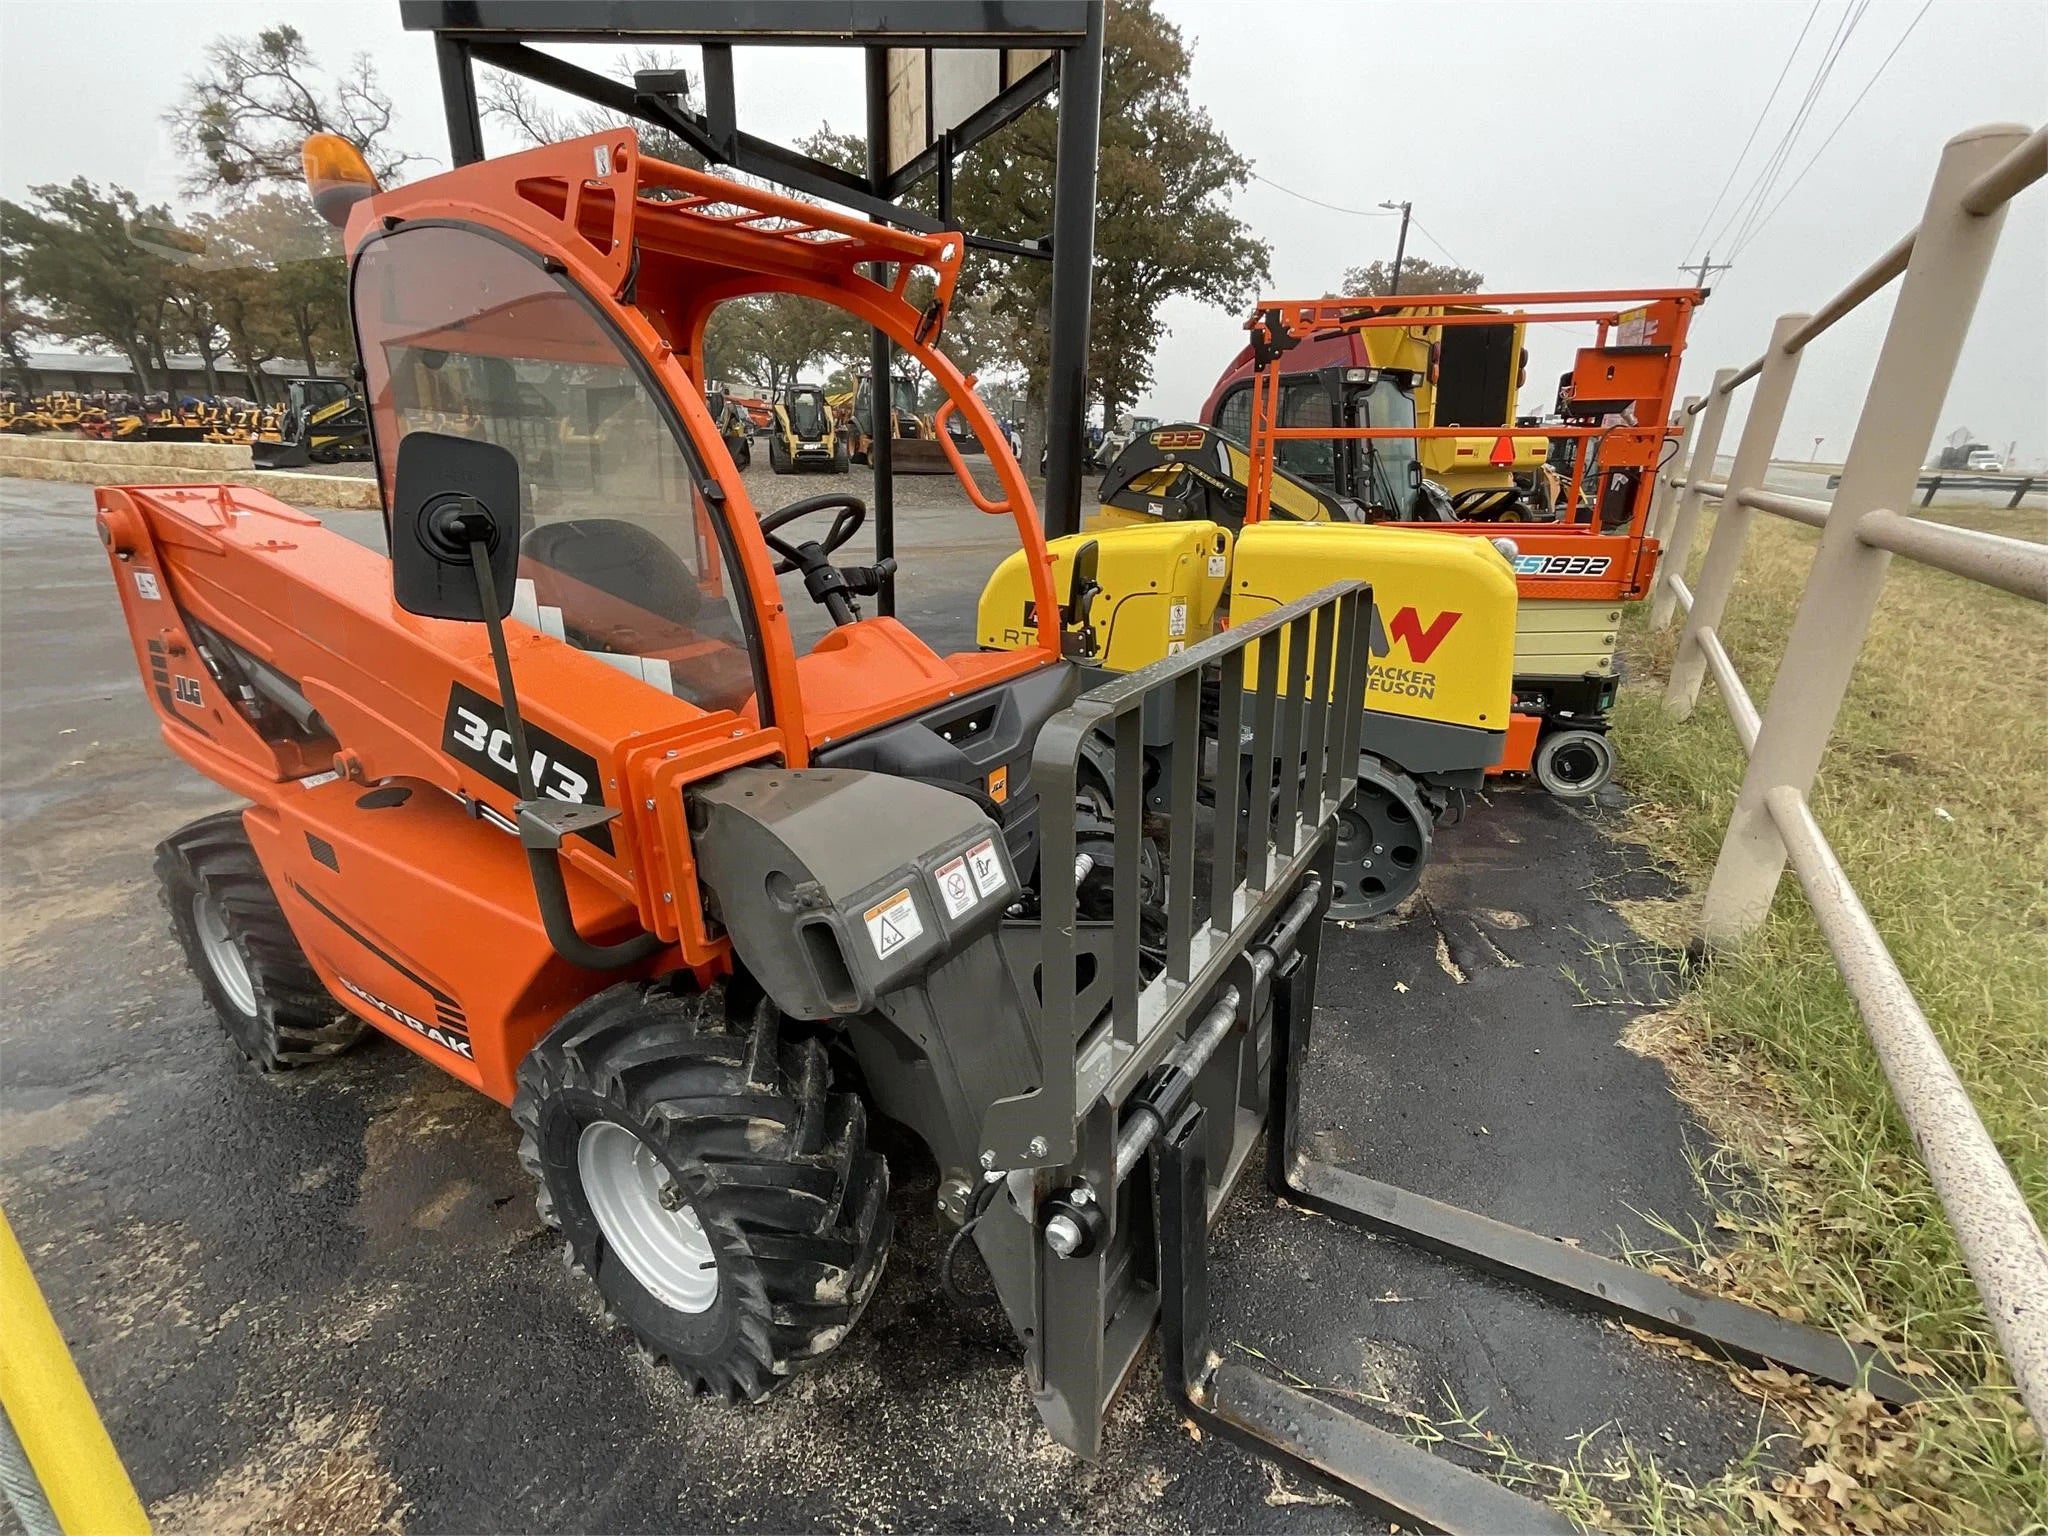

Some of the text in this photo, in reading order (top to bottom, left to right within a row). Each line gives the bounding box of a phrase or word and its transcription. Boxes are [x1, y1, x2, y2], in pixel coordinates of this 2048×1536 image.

[1003, 628, 1041, 646] RT
[174, 675, 204, 707] JLG
[1366, 678, 1435, 700] EUSON
[453, 706, 588, 804] 3013
